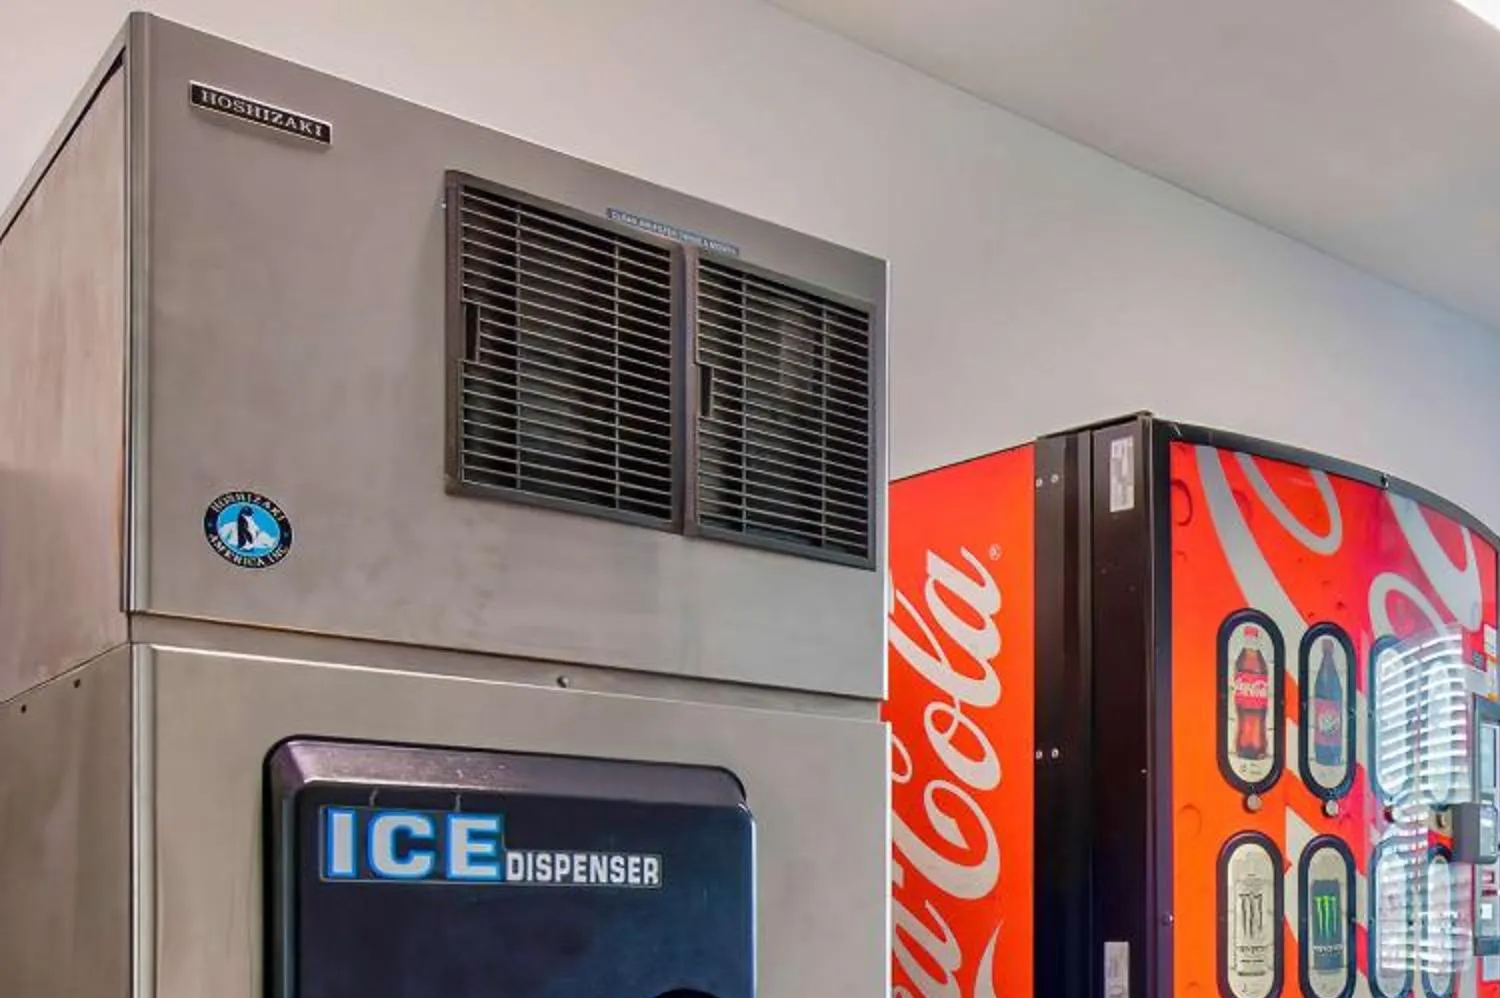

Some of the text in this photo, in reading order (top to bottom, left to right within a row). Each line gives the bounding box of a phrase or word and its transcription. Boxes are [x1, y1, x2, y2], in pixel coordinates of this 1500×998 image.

[201, 89, 322, 137] HOSHIZAKI
[327, 806, 660, 886] ICE DISPENSER
